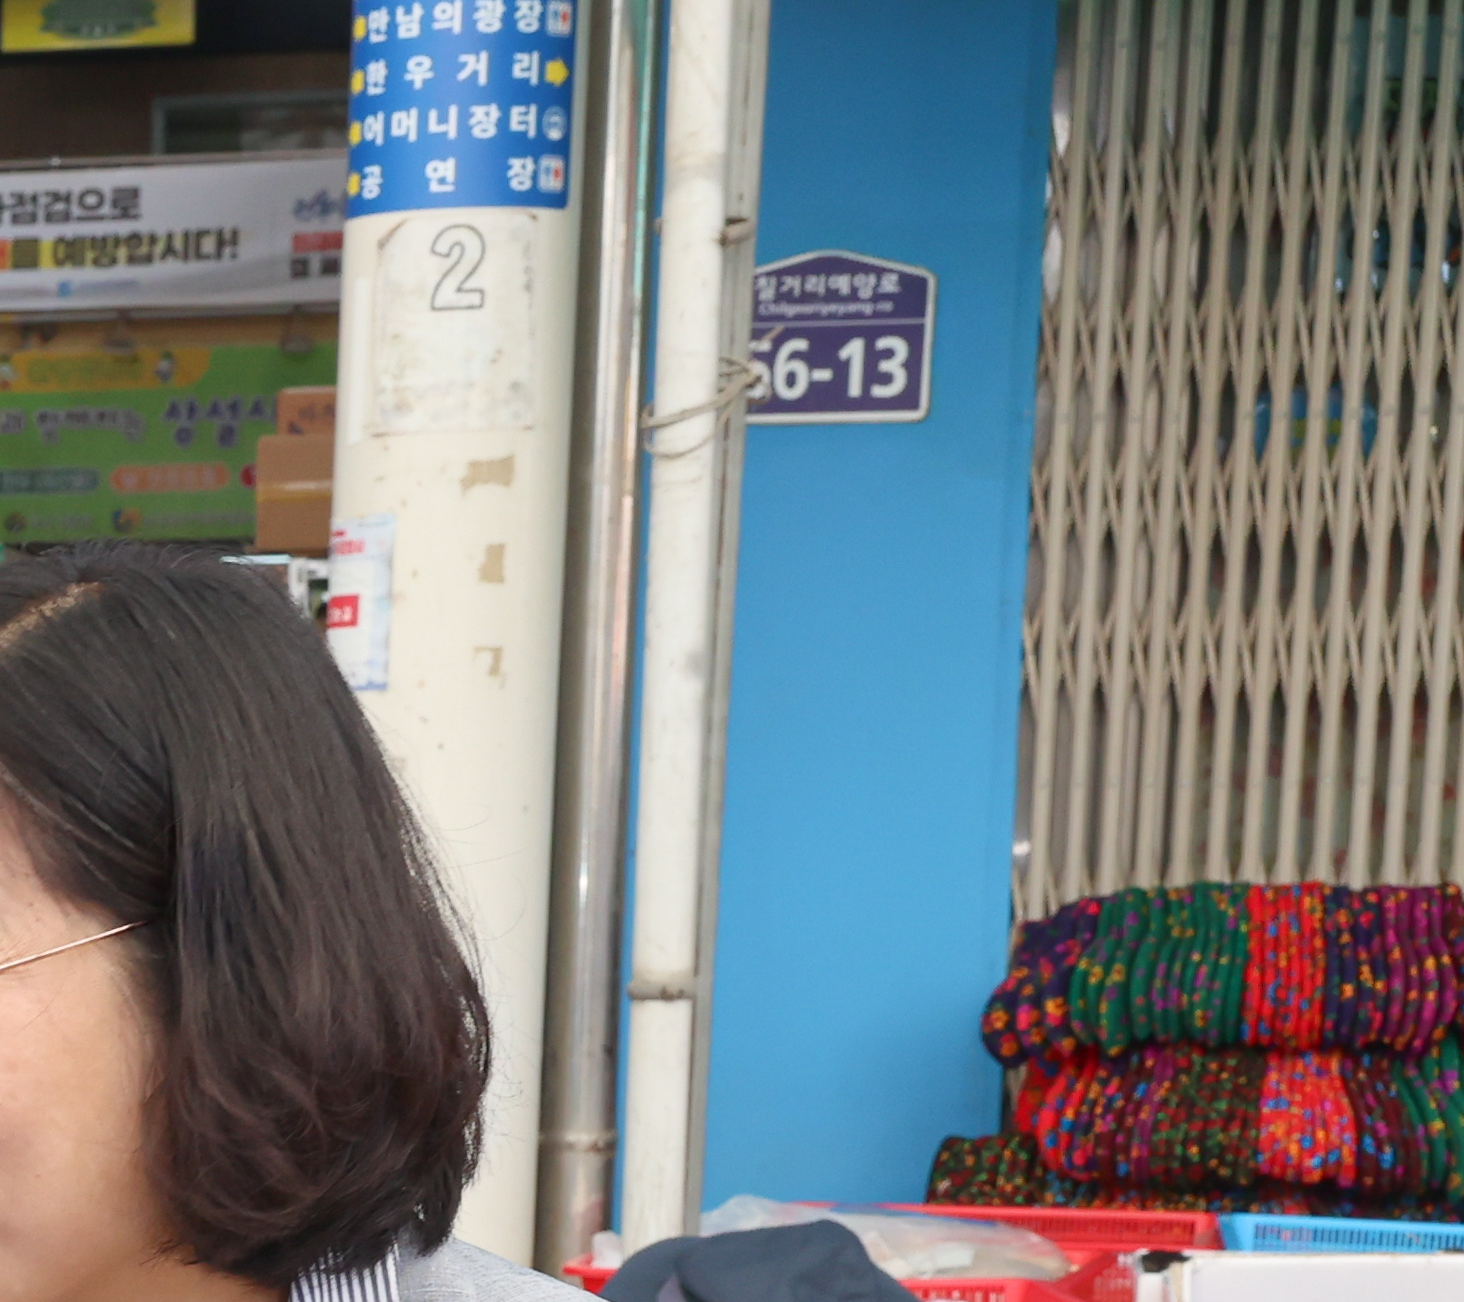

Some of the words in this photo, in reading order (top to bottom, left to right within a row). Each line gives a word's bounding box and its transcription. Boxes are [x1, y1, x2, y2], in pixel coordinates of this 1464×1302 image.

[367, 0, 543, 44] 만남의광장
[362, 103, 539, 147] 어머니장터
[430, 225, 486, 311] 2
